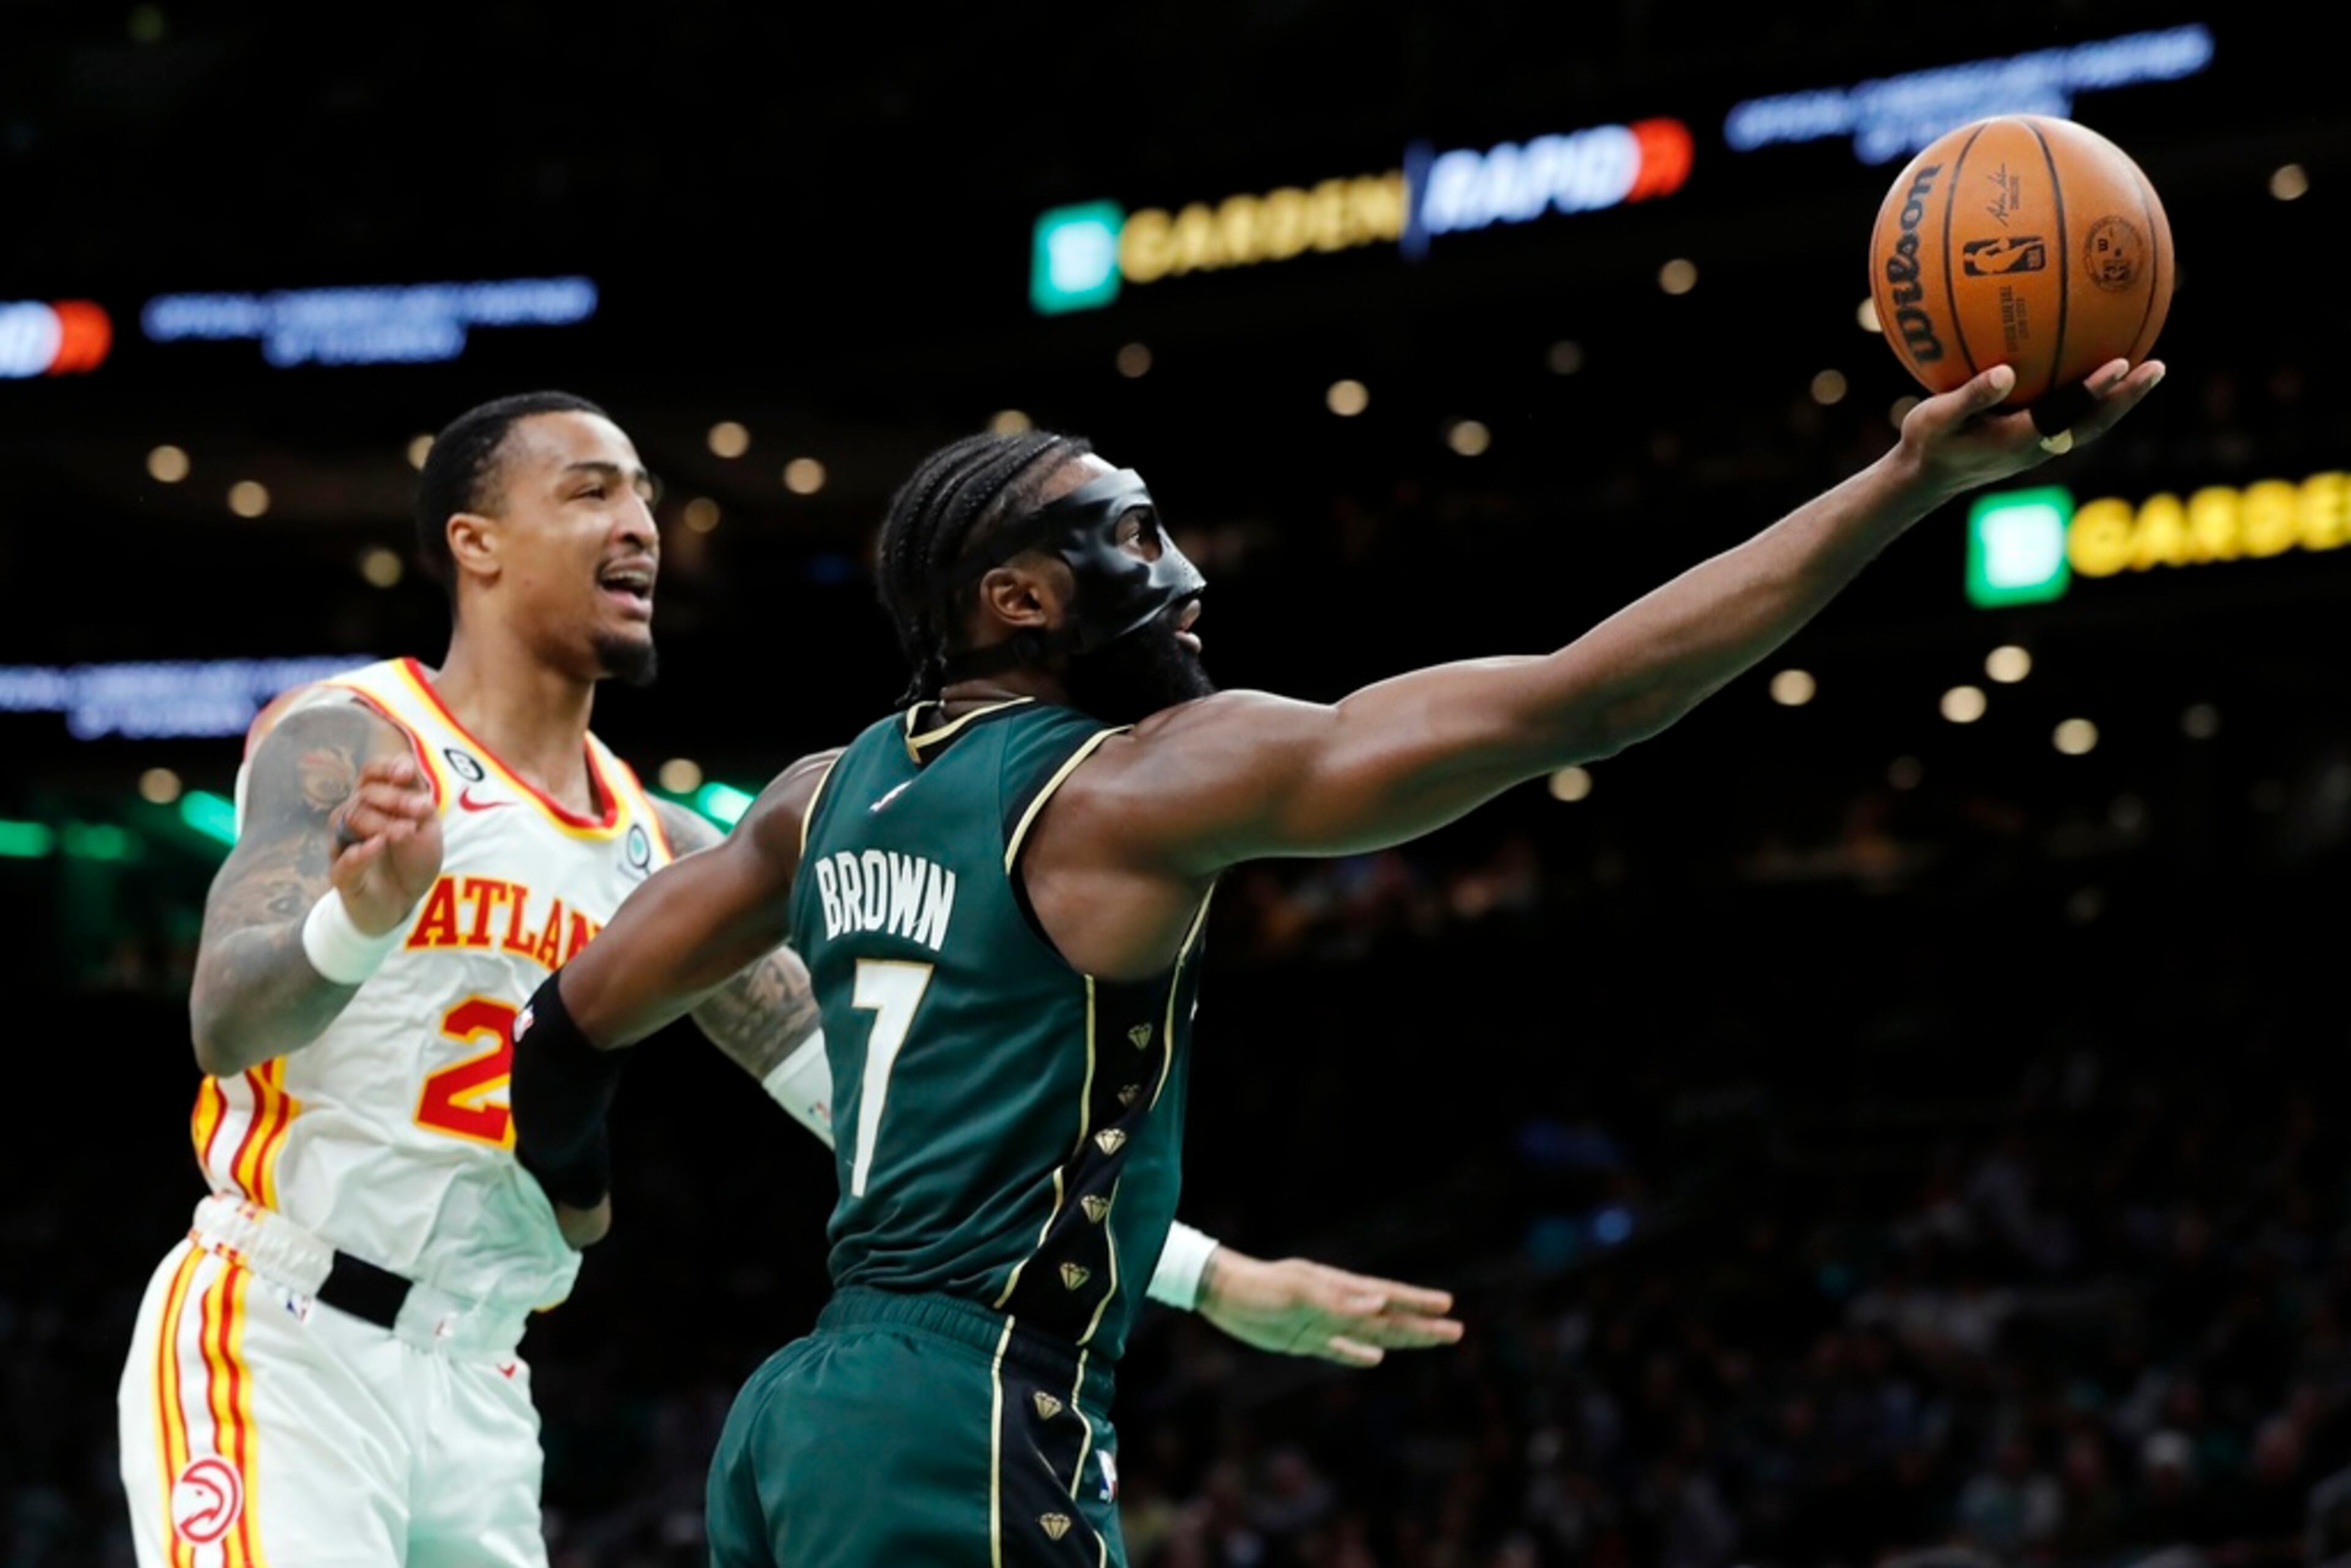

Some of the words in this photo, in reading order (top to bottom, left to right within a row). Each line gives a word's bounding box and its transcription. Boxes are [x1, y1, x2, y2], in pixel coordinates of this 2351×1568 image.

[1886, 162, 1944, 363] Wilson
[815, 849, 956, 952] BROWN
[413, 993, 518, 1152] 2
[852, 957, 936, 1198] 7
